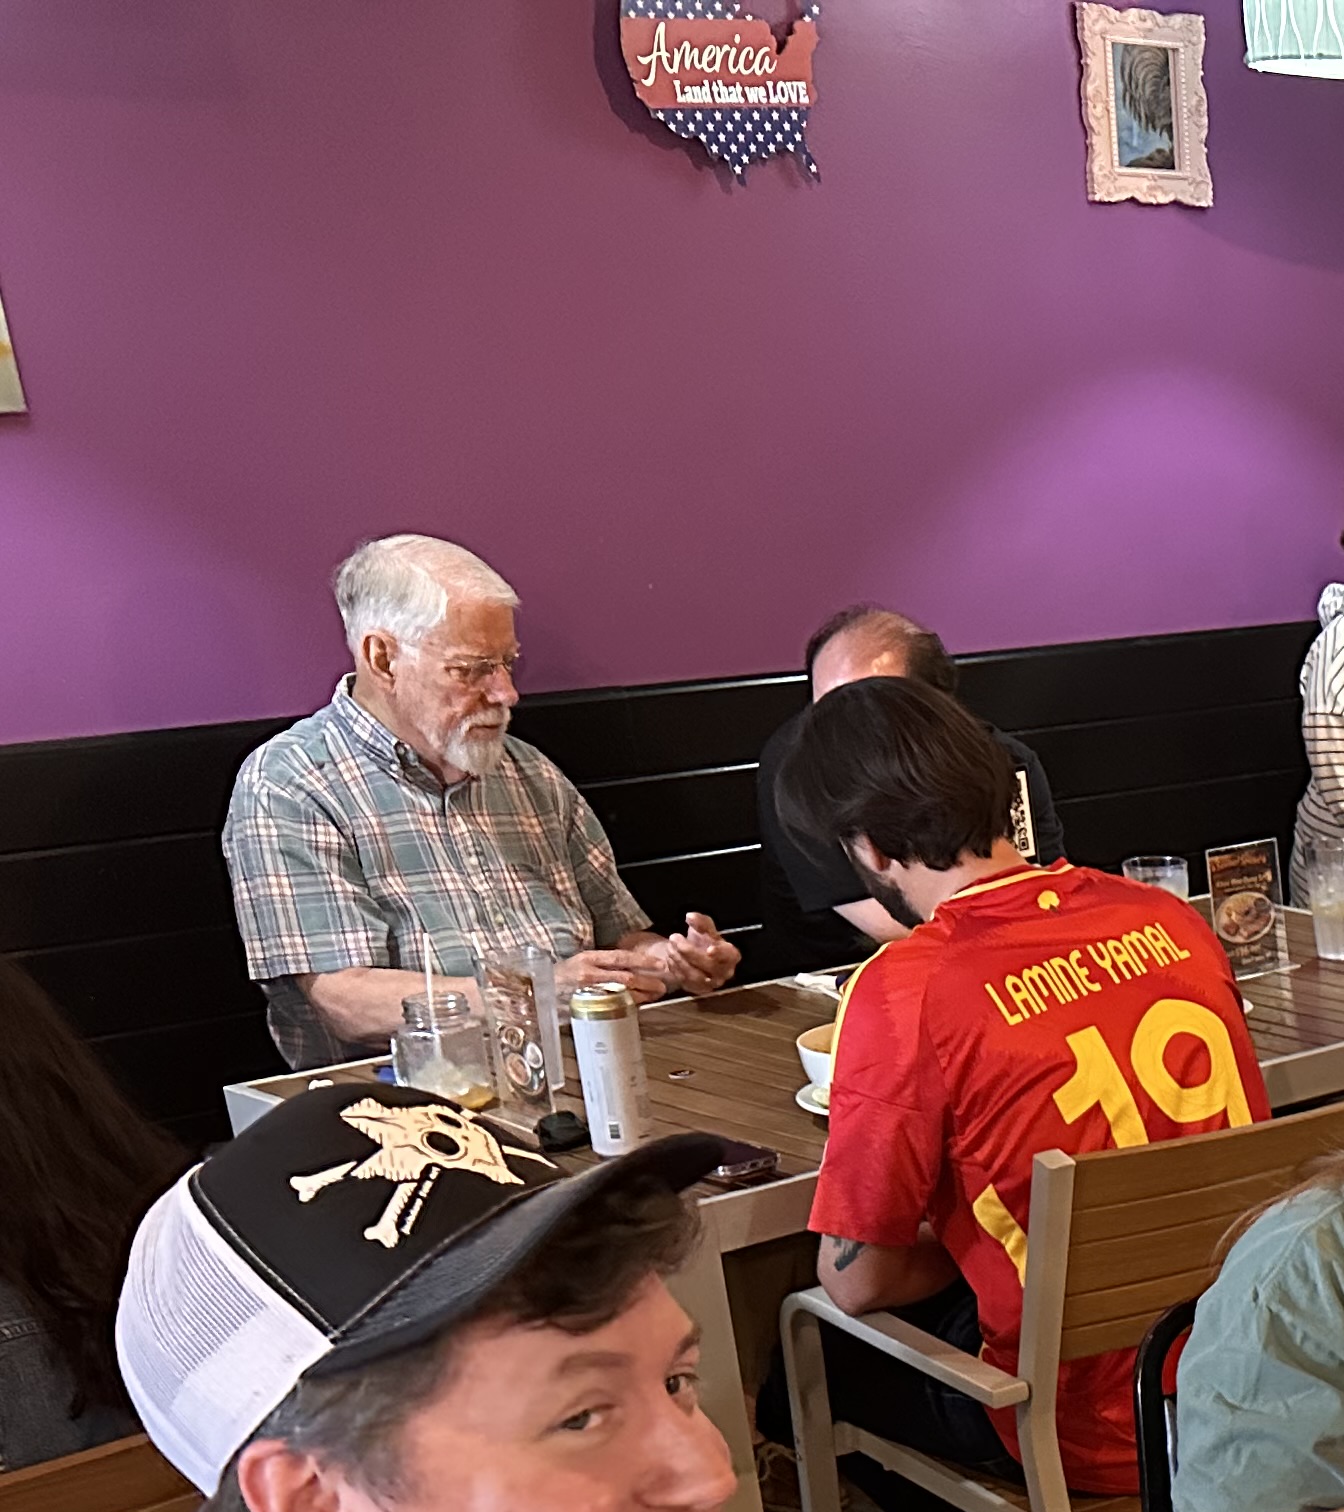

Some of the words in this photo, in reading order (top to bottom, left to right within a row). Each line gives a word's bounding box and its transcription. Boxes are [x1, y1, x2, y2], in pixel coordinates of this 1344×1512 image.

[637, 22, 778, 87] America
[673, 79, 713, 104] Land
[711, 79, 745, 104] that
[744, 85, 767, 104] we
[766, 80, 810, 104] LOVE
[984, 949, 1102, 1026] LAMINE
[1086, 921, 1191, 985] YAMAL
[1052, 998, 1253, 1149] 19
